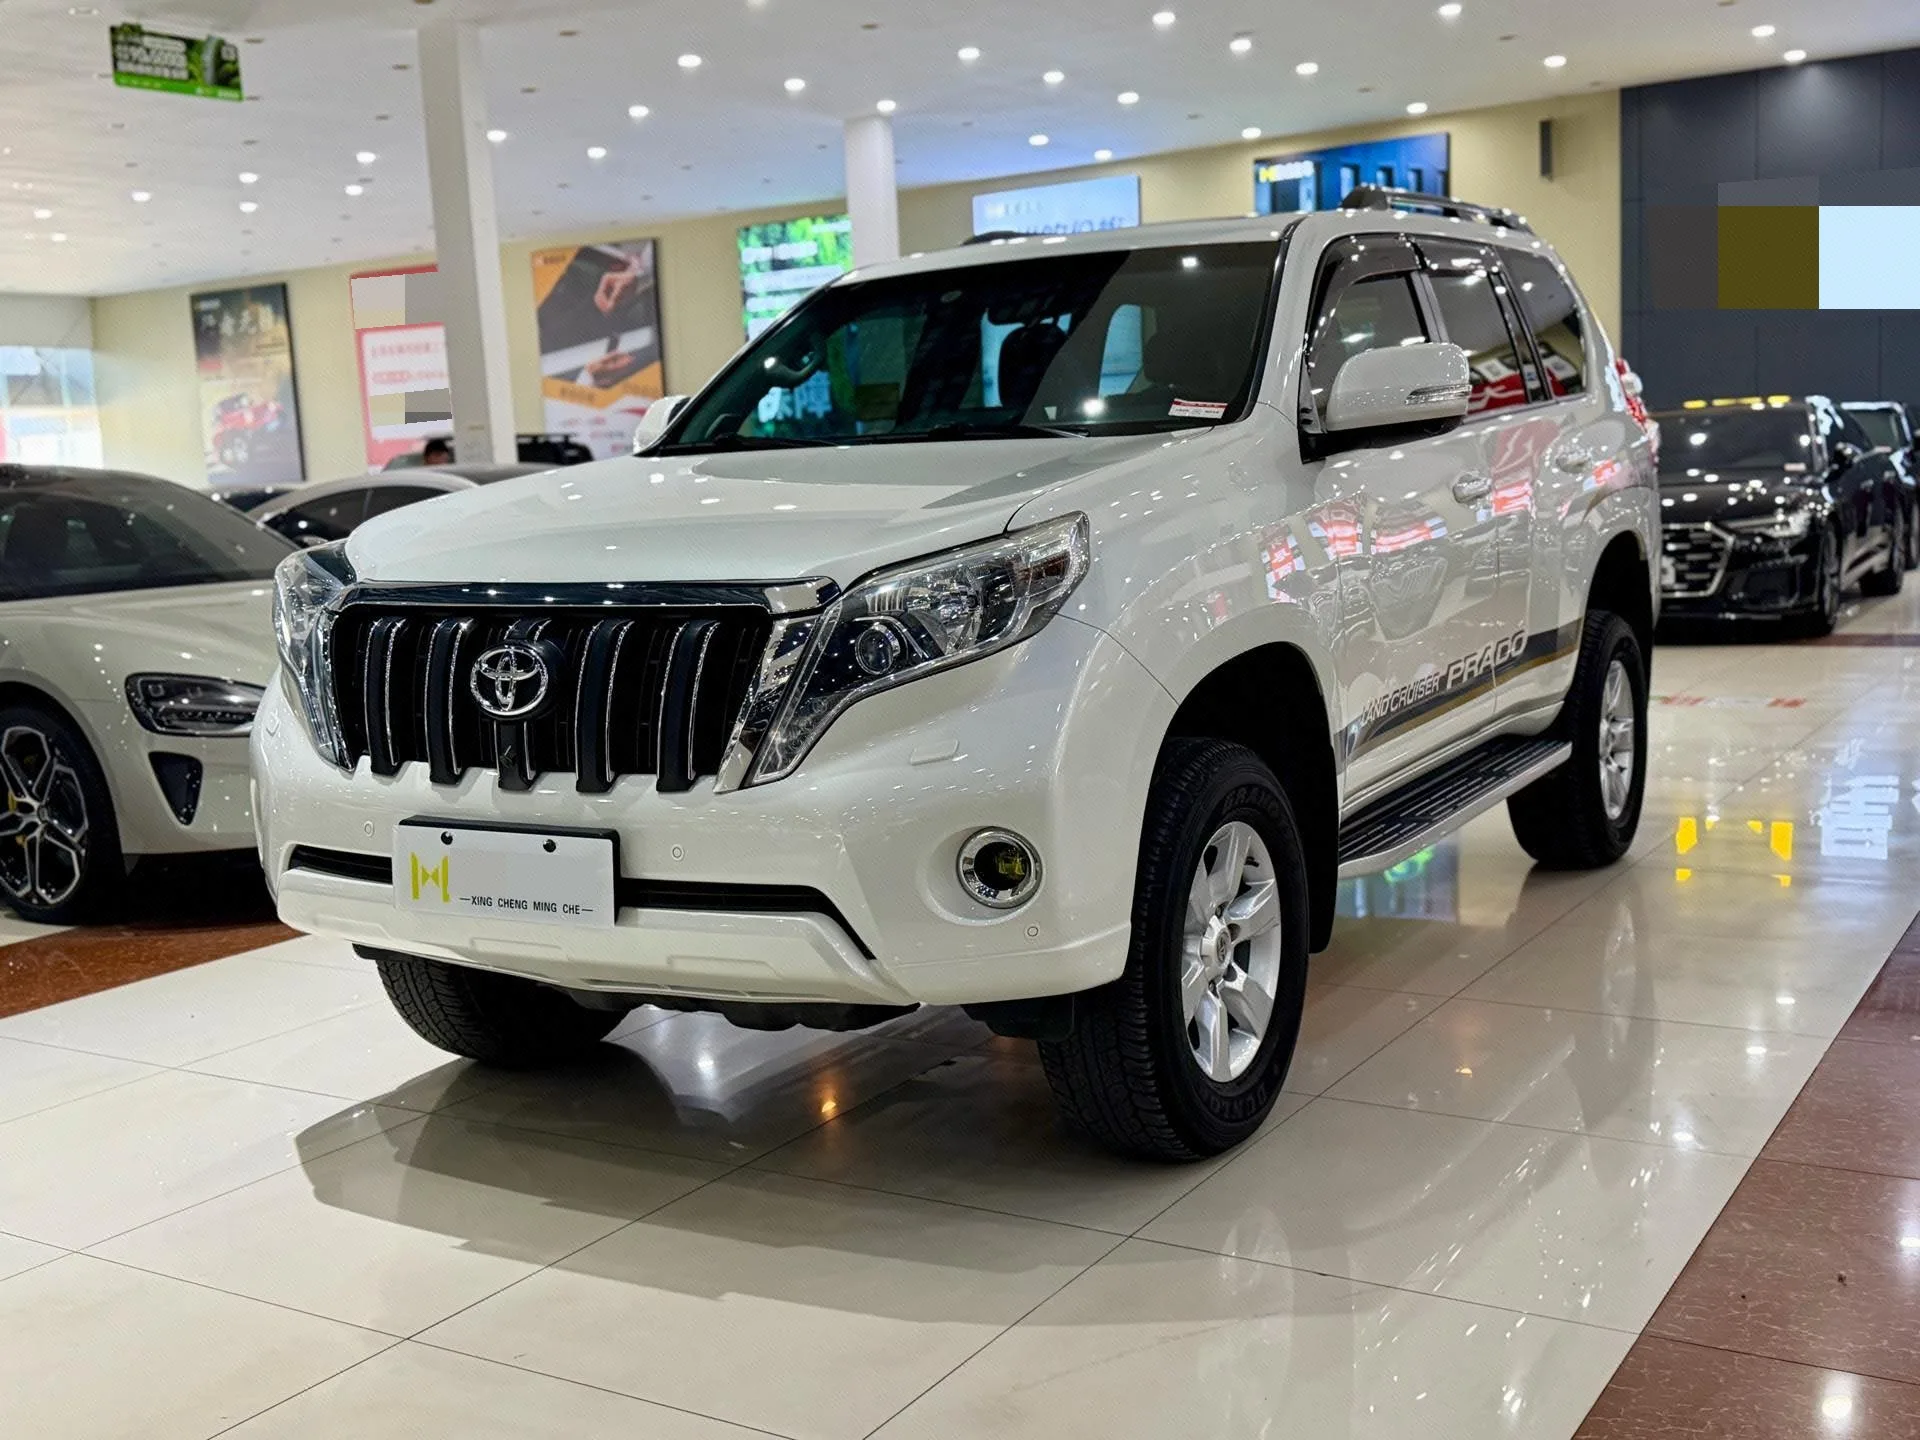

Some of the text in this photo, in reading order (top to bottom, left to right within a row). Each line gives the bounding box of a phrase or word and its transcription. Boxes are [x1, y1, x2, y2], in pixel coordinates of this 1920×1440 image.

[1360, 630, 1529, 726] LAND CRUISER PRADO
[471, 895, 581, 915] XING CHENG MING CHE
